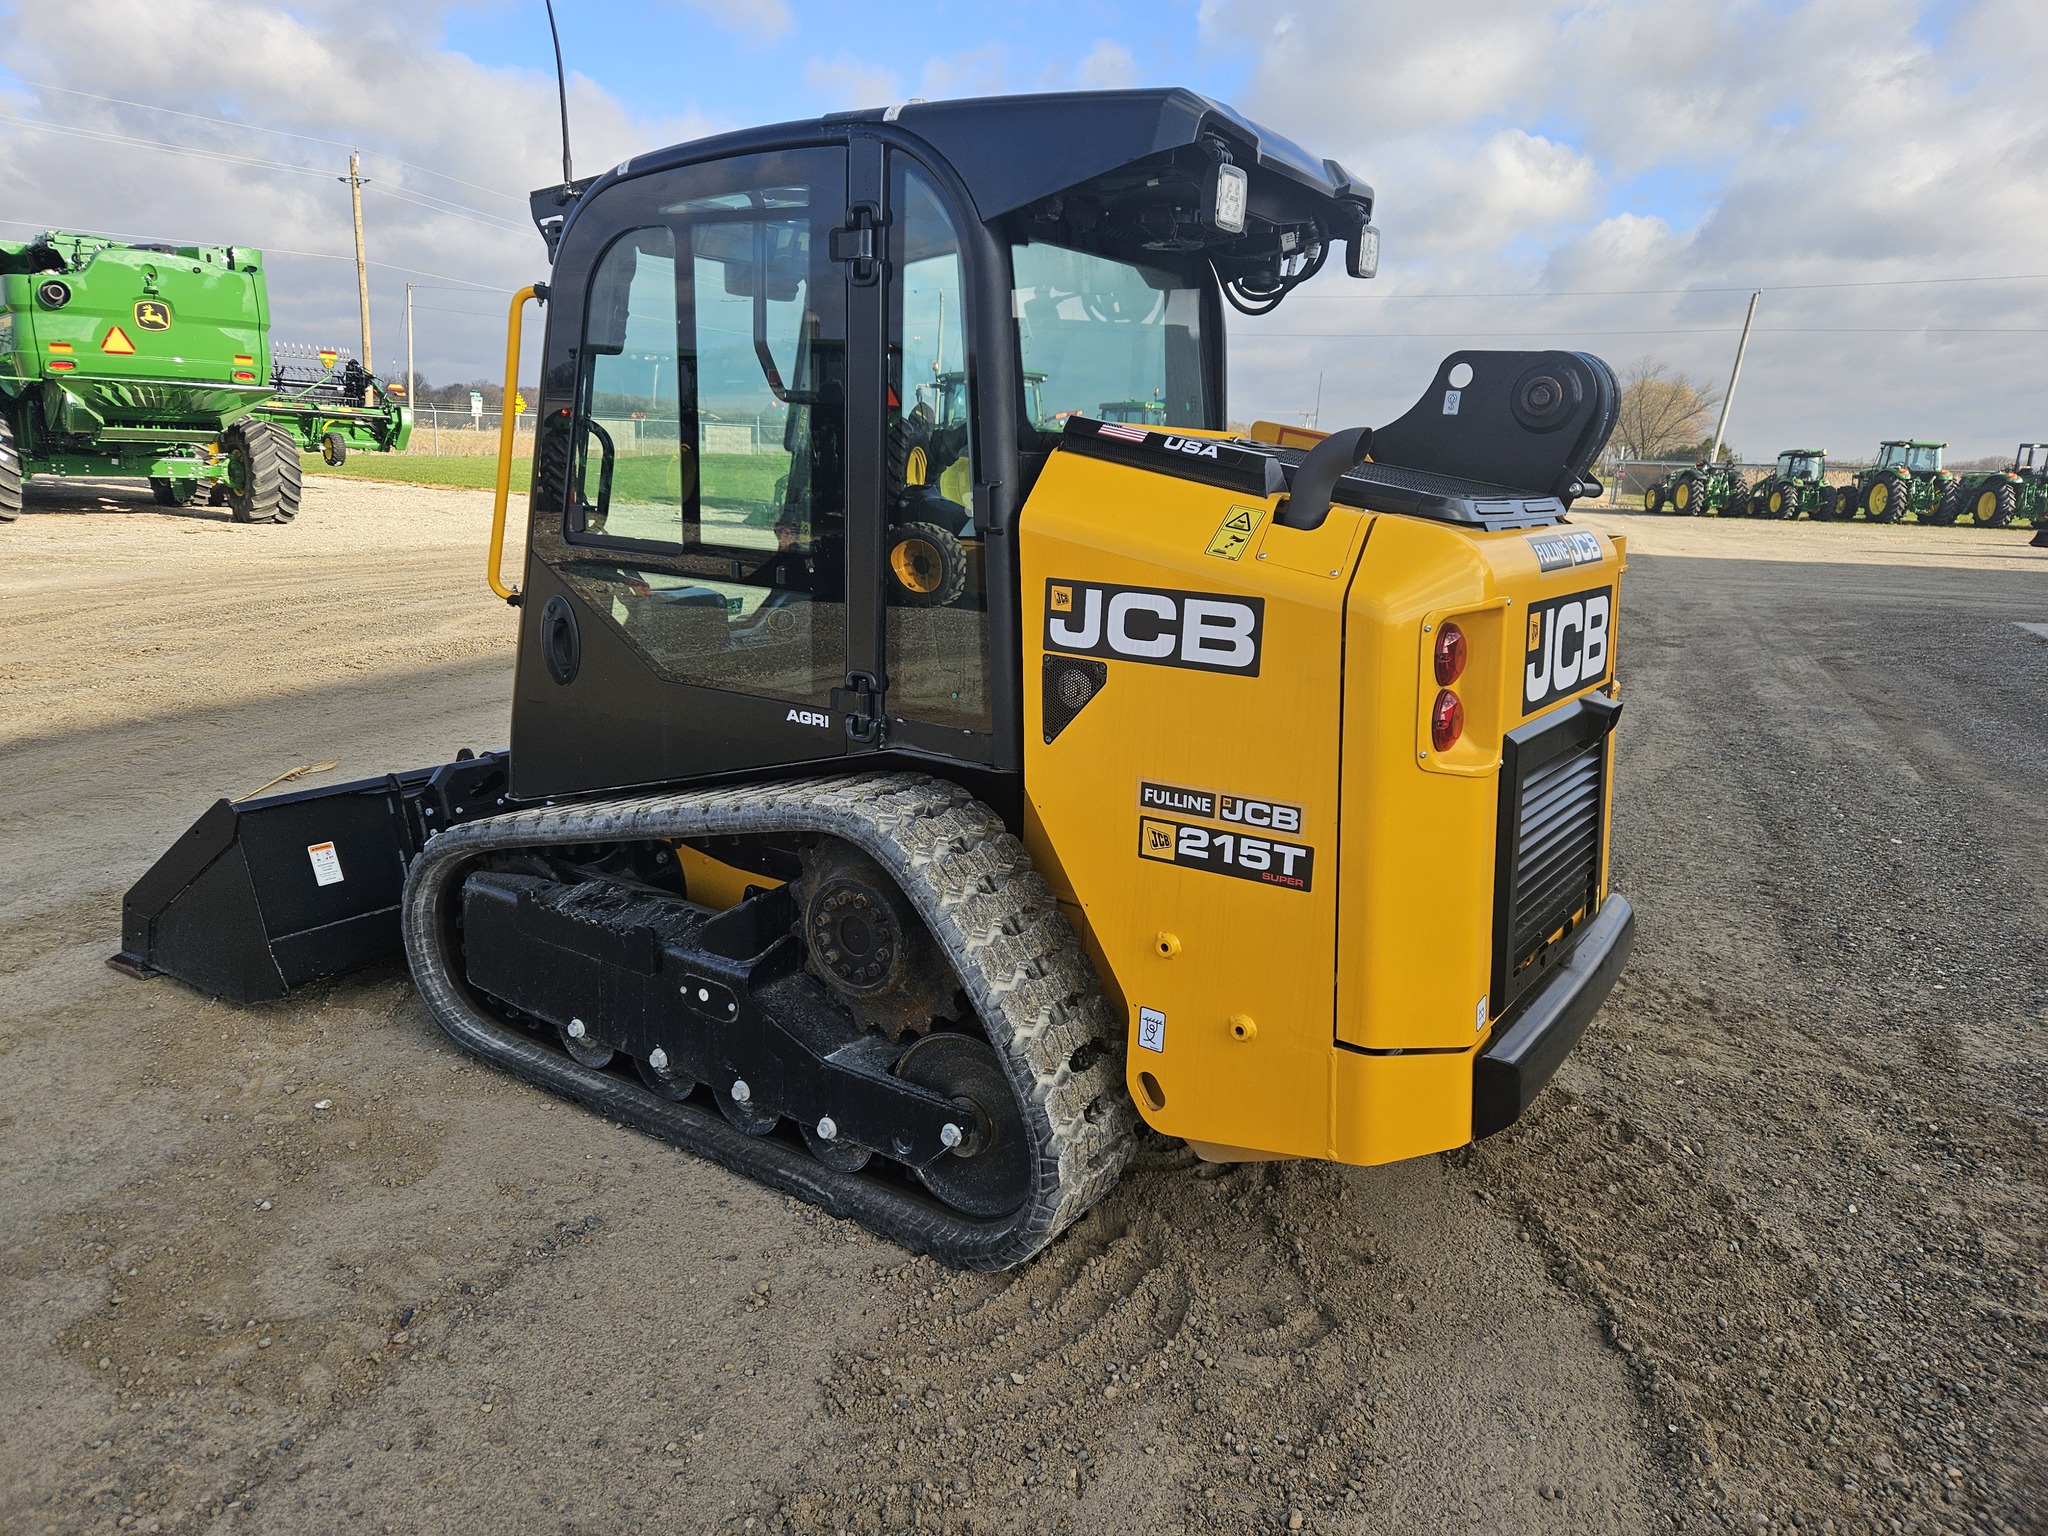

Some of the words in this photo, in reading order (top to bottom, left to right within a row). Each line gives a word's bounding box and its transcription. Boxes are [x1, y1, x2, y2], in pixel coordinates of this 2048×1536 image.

[1163, 436, 1218, 459] USA
[1533, 540, 1570, 564] FULLINE
[1568, 533, 1602, 563] JCB
[1050, 588, 1255, 667] JCB
[1526, 595, 1609, 702] JCB
[786, 709, 829, 728] AGRI
[1144, 788, 1211, 813] FULLINE
[1221, 799, 1299, 831] JCB
[1150, 830, 1171, 848] JCB
[1178, 826, 1306, 876] 215T
[1261, 872, 1304, 888] SUPER
